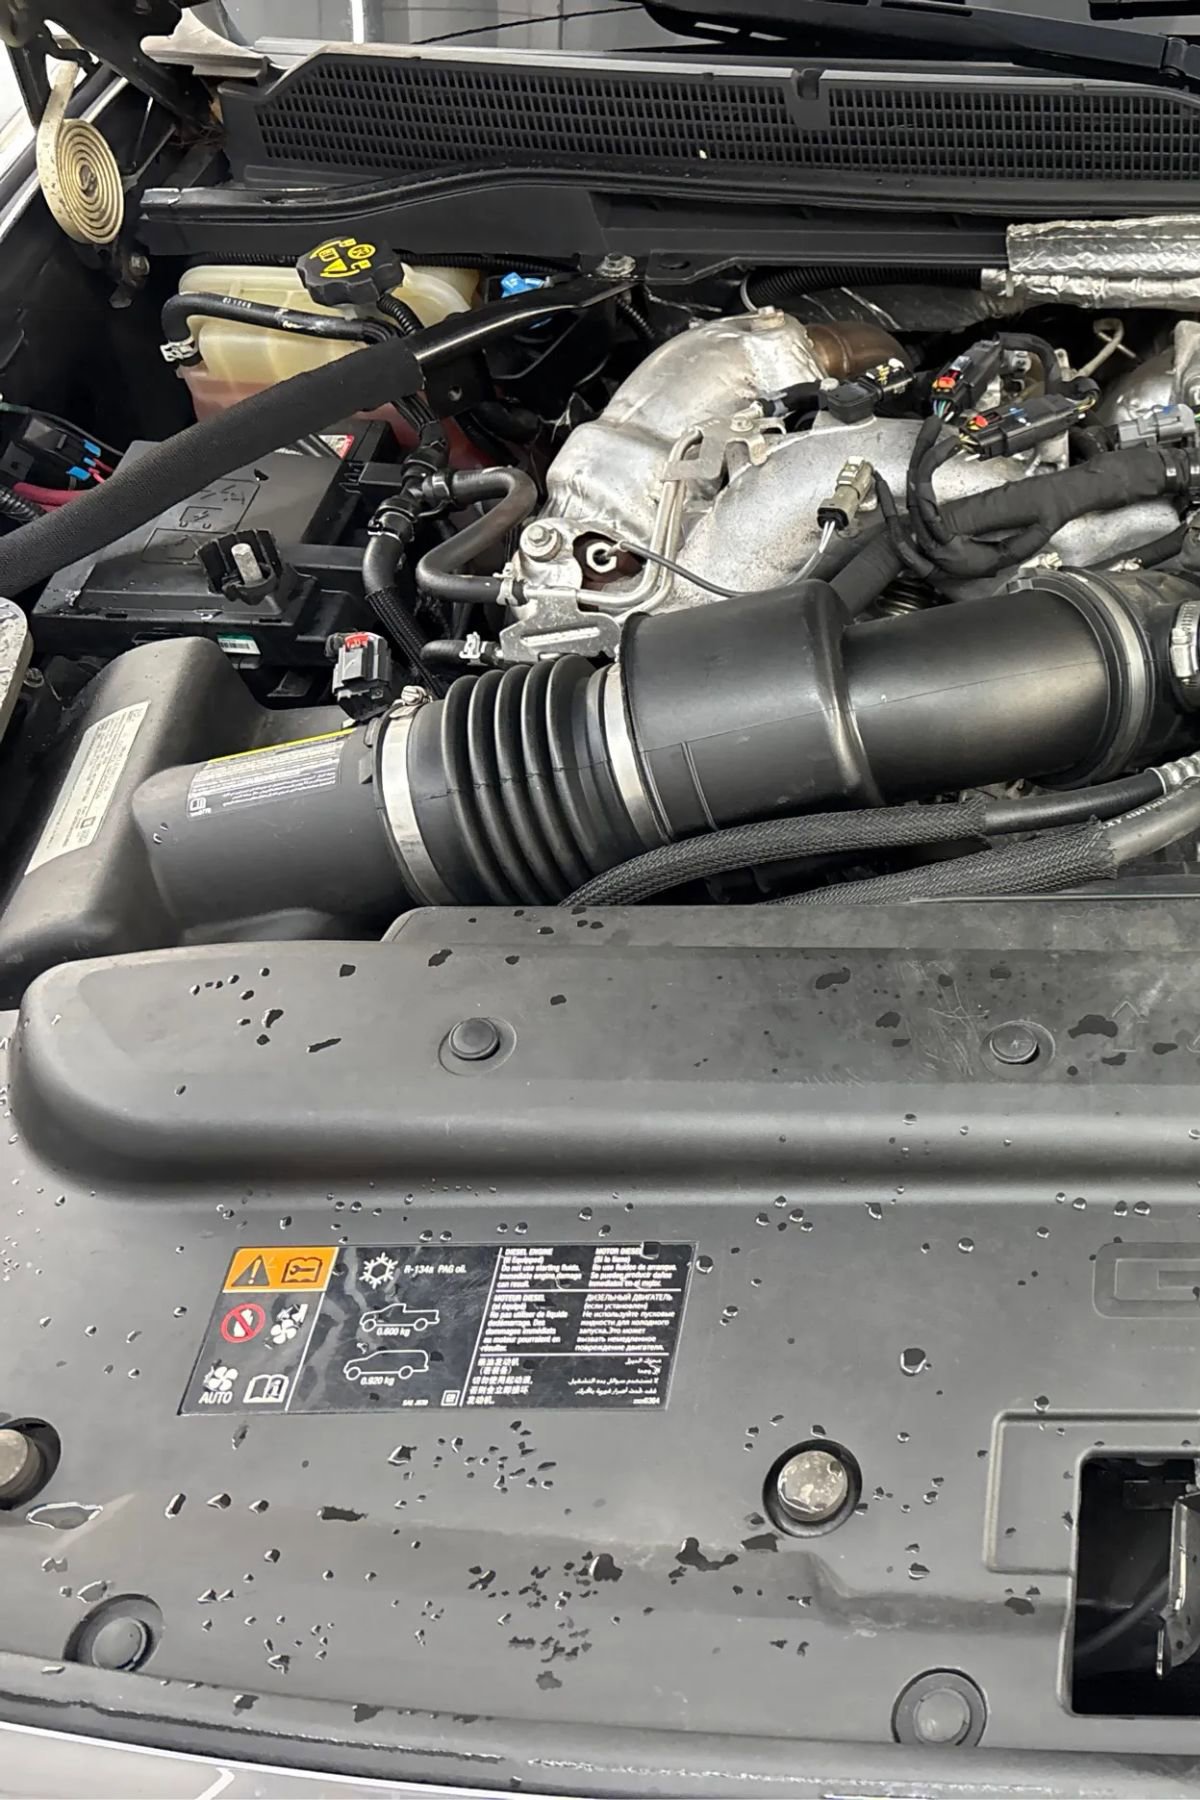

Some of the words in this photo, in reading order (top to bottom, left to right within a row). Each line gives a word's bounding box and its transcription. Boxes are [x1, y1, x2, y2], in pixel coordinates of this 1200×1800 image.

[403, 1265, 434, 1274] R-134a
[437, 1265, 454, 1274] PAG
[400, 1327, 411, 1337] kg
[384, 1376, 395, 1386] kg
[198, 1391, 233, 1404] AUTO
